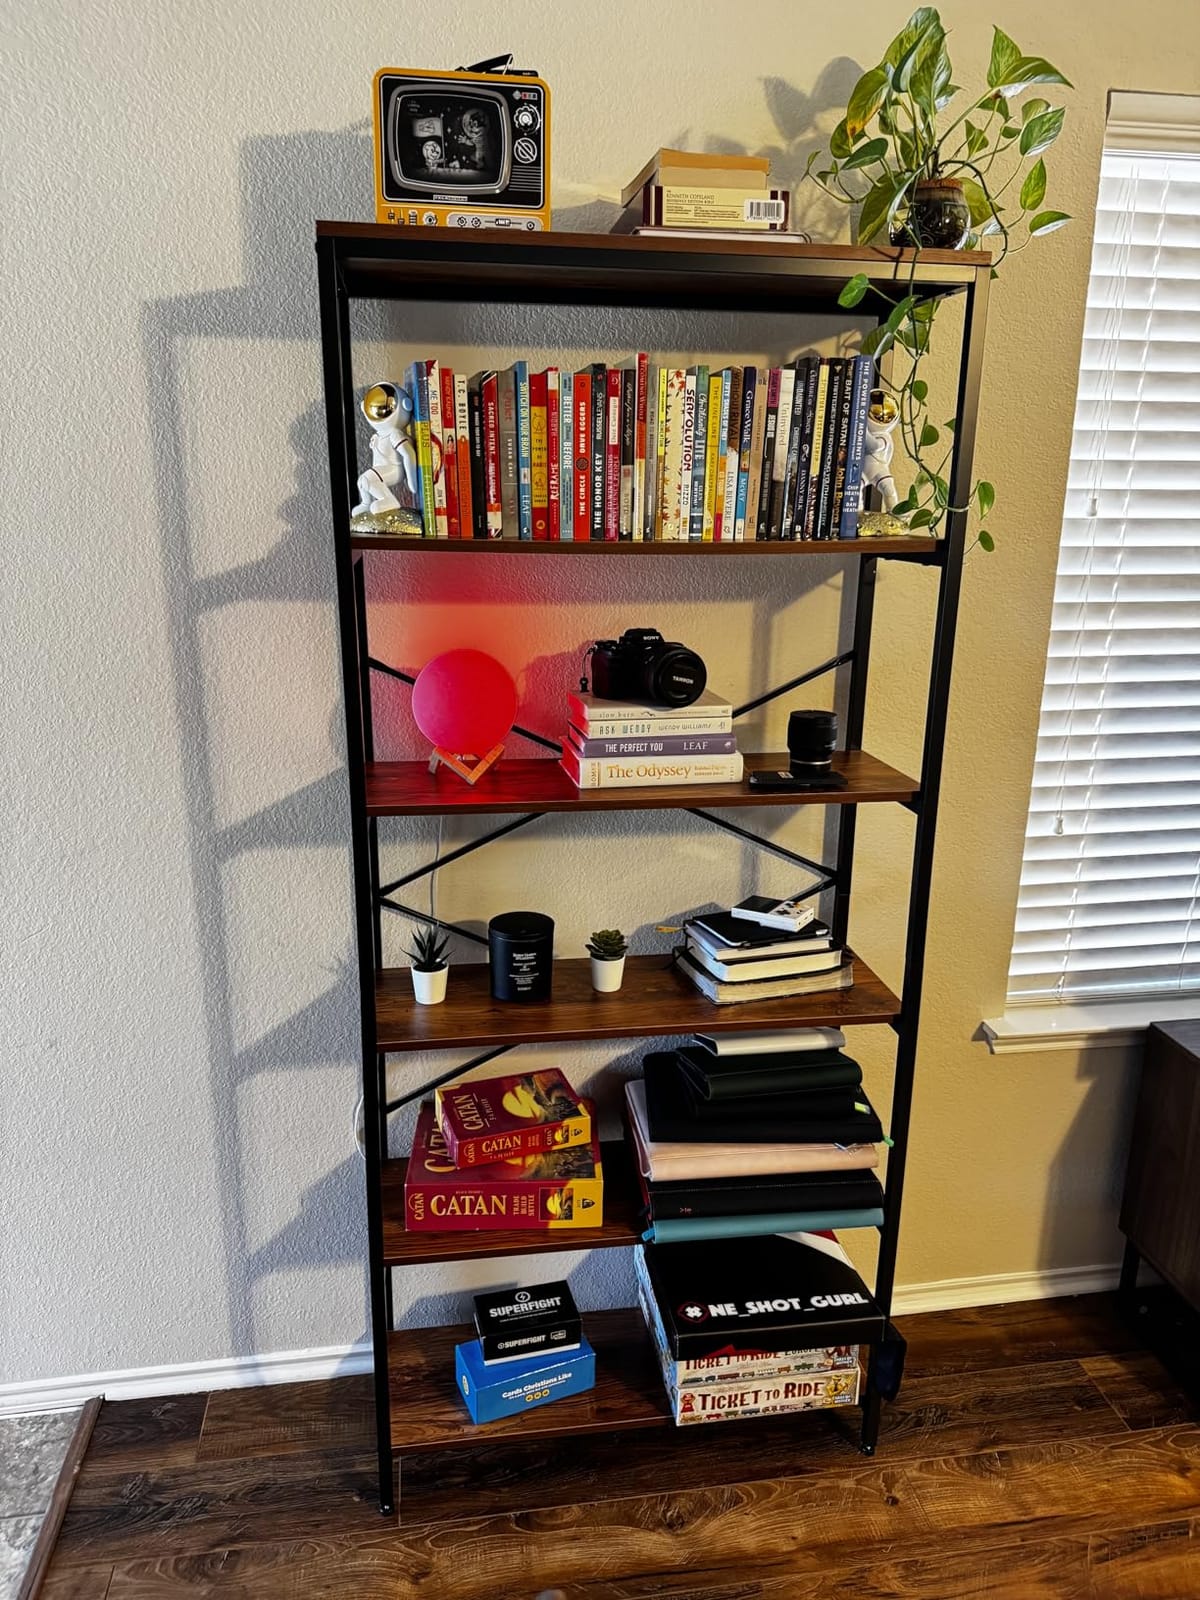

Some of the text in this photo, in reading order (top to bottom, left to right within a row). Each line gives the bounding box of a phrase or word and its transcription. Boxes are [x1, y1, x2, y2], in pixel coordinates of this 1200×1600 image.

[863, 361, 871, 376] THE
[809, 369, 818, 397] CULTURE
[844, 379, 853, 401] BAIT
[860, 379, 869, 408] POWER
[430, 390, 439, 416] ME TOO
[457, 380, 467, 430] T.C. BOYLE
[562, 395, 572, 424] BETTER
[843, 402, 850, 416] OF
[859, 409, 866, 420] OF
[520, 382, 530, 458] SWITCH ON YOUR BRAIN
[684, 388, 695, 472] SERVOLUTION
[730, 410, 740, 441] RIVAL
[743, 390, 754, 444] Grace Walk
[779, 402, 790, 447] Uninvited
[420, 421, 431, 448] PLUS
[840, 417, 849, 446] SATAN
[856, 422, 865, 461] MOMENTS
[562, 441, 572, 470] BEFORE
[694, 439, 705, 460] LITE
[594, 452, 602, 529] THE HONOR KEY
[799, 470, 807, 494] DANNY
[836, 467, 846, 489] John
[725, 471, 735, 521] LISA BEVERE
[599, 725, 616, 736] ASK
[622, 723, 652, 735] WENDY
[605, 742, 664, 753] THE PERFECT YOU
[683, 741, 709, 751] LEAF
[607, 765, 632, 778] The
[636, 762, 691, 781] Odyssey
[452, 1094, 485, 1131] CATAN
[424, 1117, 456, 1173] CAT
[481, 1135, 523, 1154] CATAN
[414, 1192, 425, 1221] CATAN
[430, 1194, 508, 1217] CATAN
[489, 1296, 562, 1318] SUPERFIGHT
[504, 1334, 547, 1349] SUPERFIGHT
[502, 1388, 523, 1399] Cards
[523, 1377, 558, 1392] Christians
[558, 1372, 573, 1381] Like
[698, 1381, 826, 1412] TICKET TO RIDE
